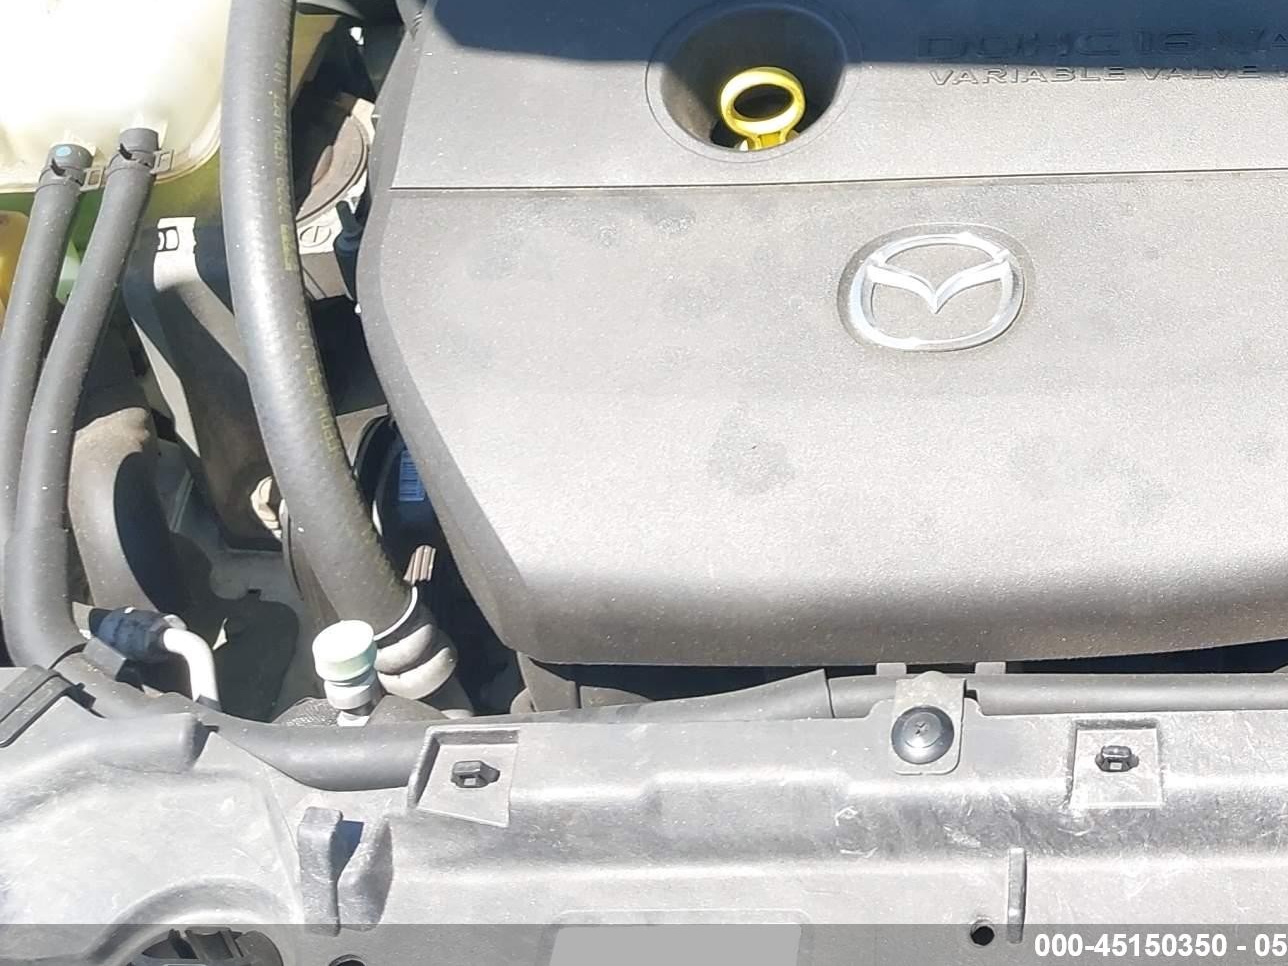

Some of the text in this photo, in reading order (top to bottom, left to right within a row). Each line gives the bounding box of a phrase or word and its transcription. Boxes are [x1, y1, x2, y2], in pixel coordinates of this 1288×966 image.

[926, 34, 1121, 59] DOHC
[1135, 28, 1199, 56] 16
[928, 66, 1127, 85] VARIABLE
[1139, 64, 1262, 80] VALVE
